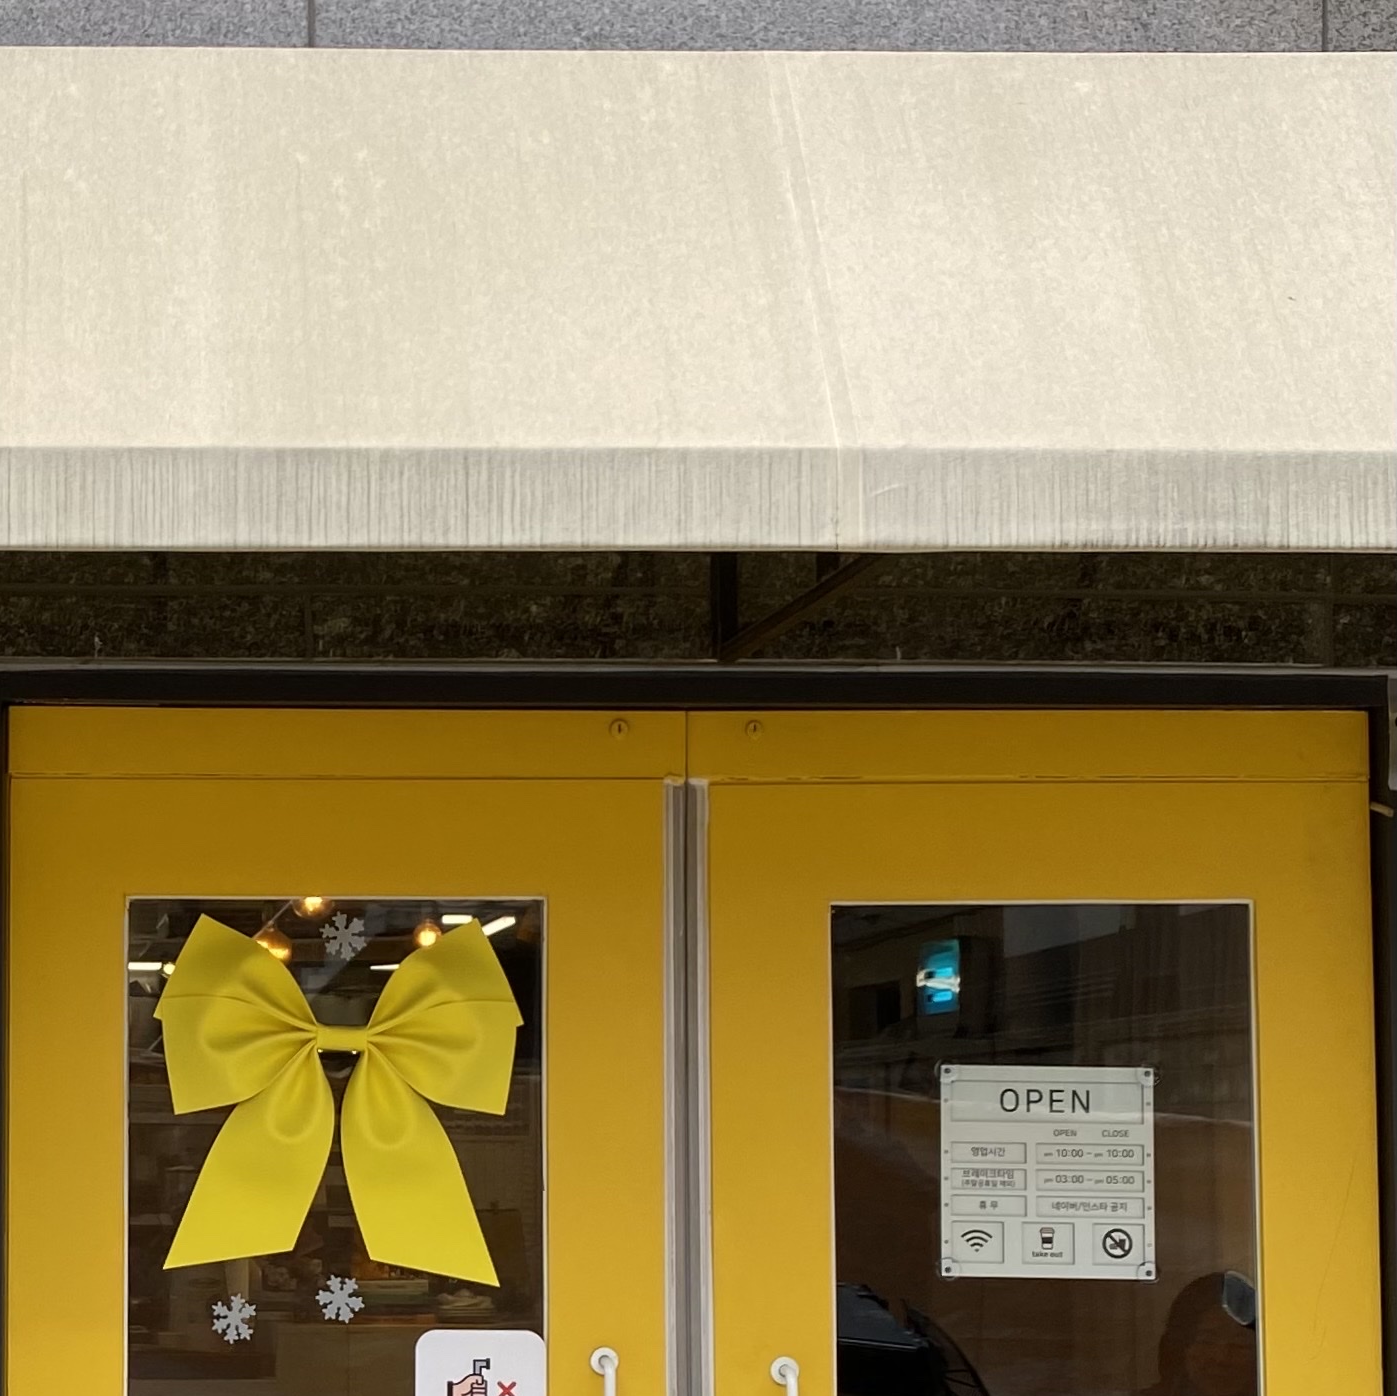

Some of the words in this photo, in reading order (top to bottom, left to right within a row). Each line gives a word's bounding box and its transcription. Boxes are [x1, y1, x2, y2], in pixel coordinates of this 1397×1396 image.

[1000, 1088, 1090, 1113] OPEN
[1053, 1129, 1077, 1137] OPEN
[1101, 1129, 1130, 1138] CLOSE
[971, 1147, 1006, 1157] 영업시간
[1056, 1148, 1084, 1158] 10:00
[1106, 1149, 1135, 1158] 10:00
[962, 1168, 1015, 1180] 브레이크타임
[1055, 1174, 1084, 1184] 03:00
[1105, 1175, 1135, 1185] 05:00
